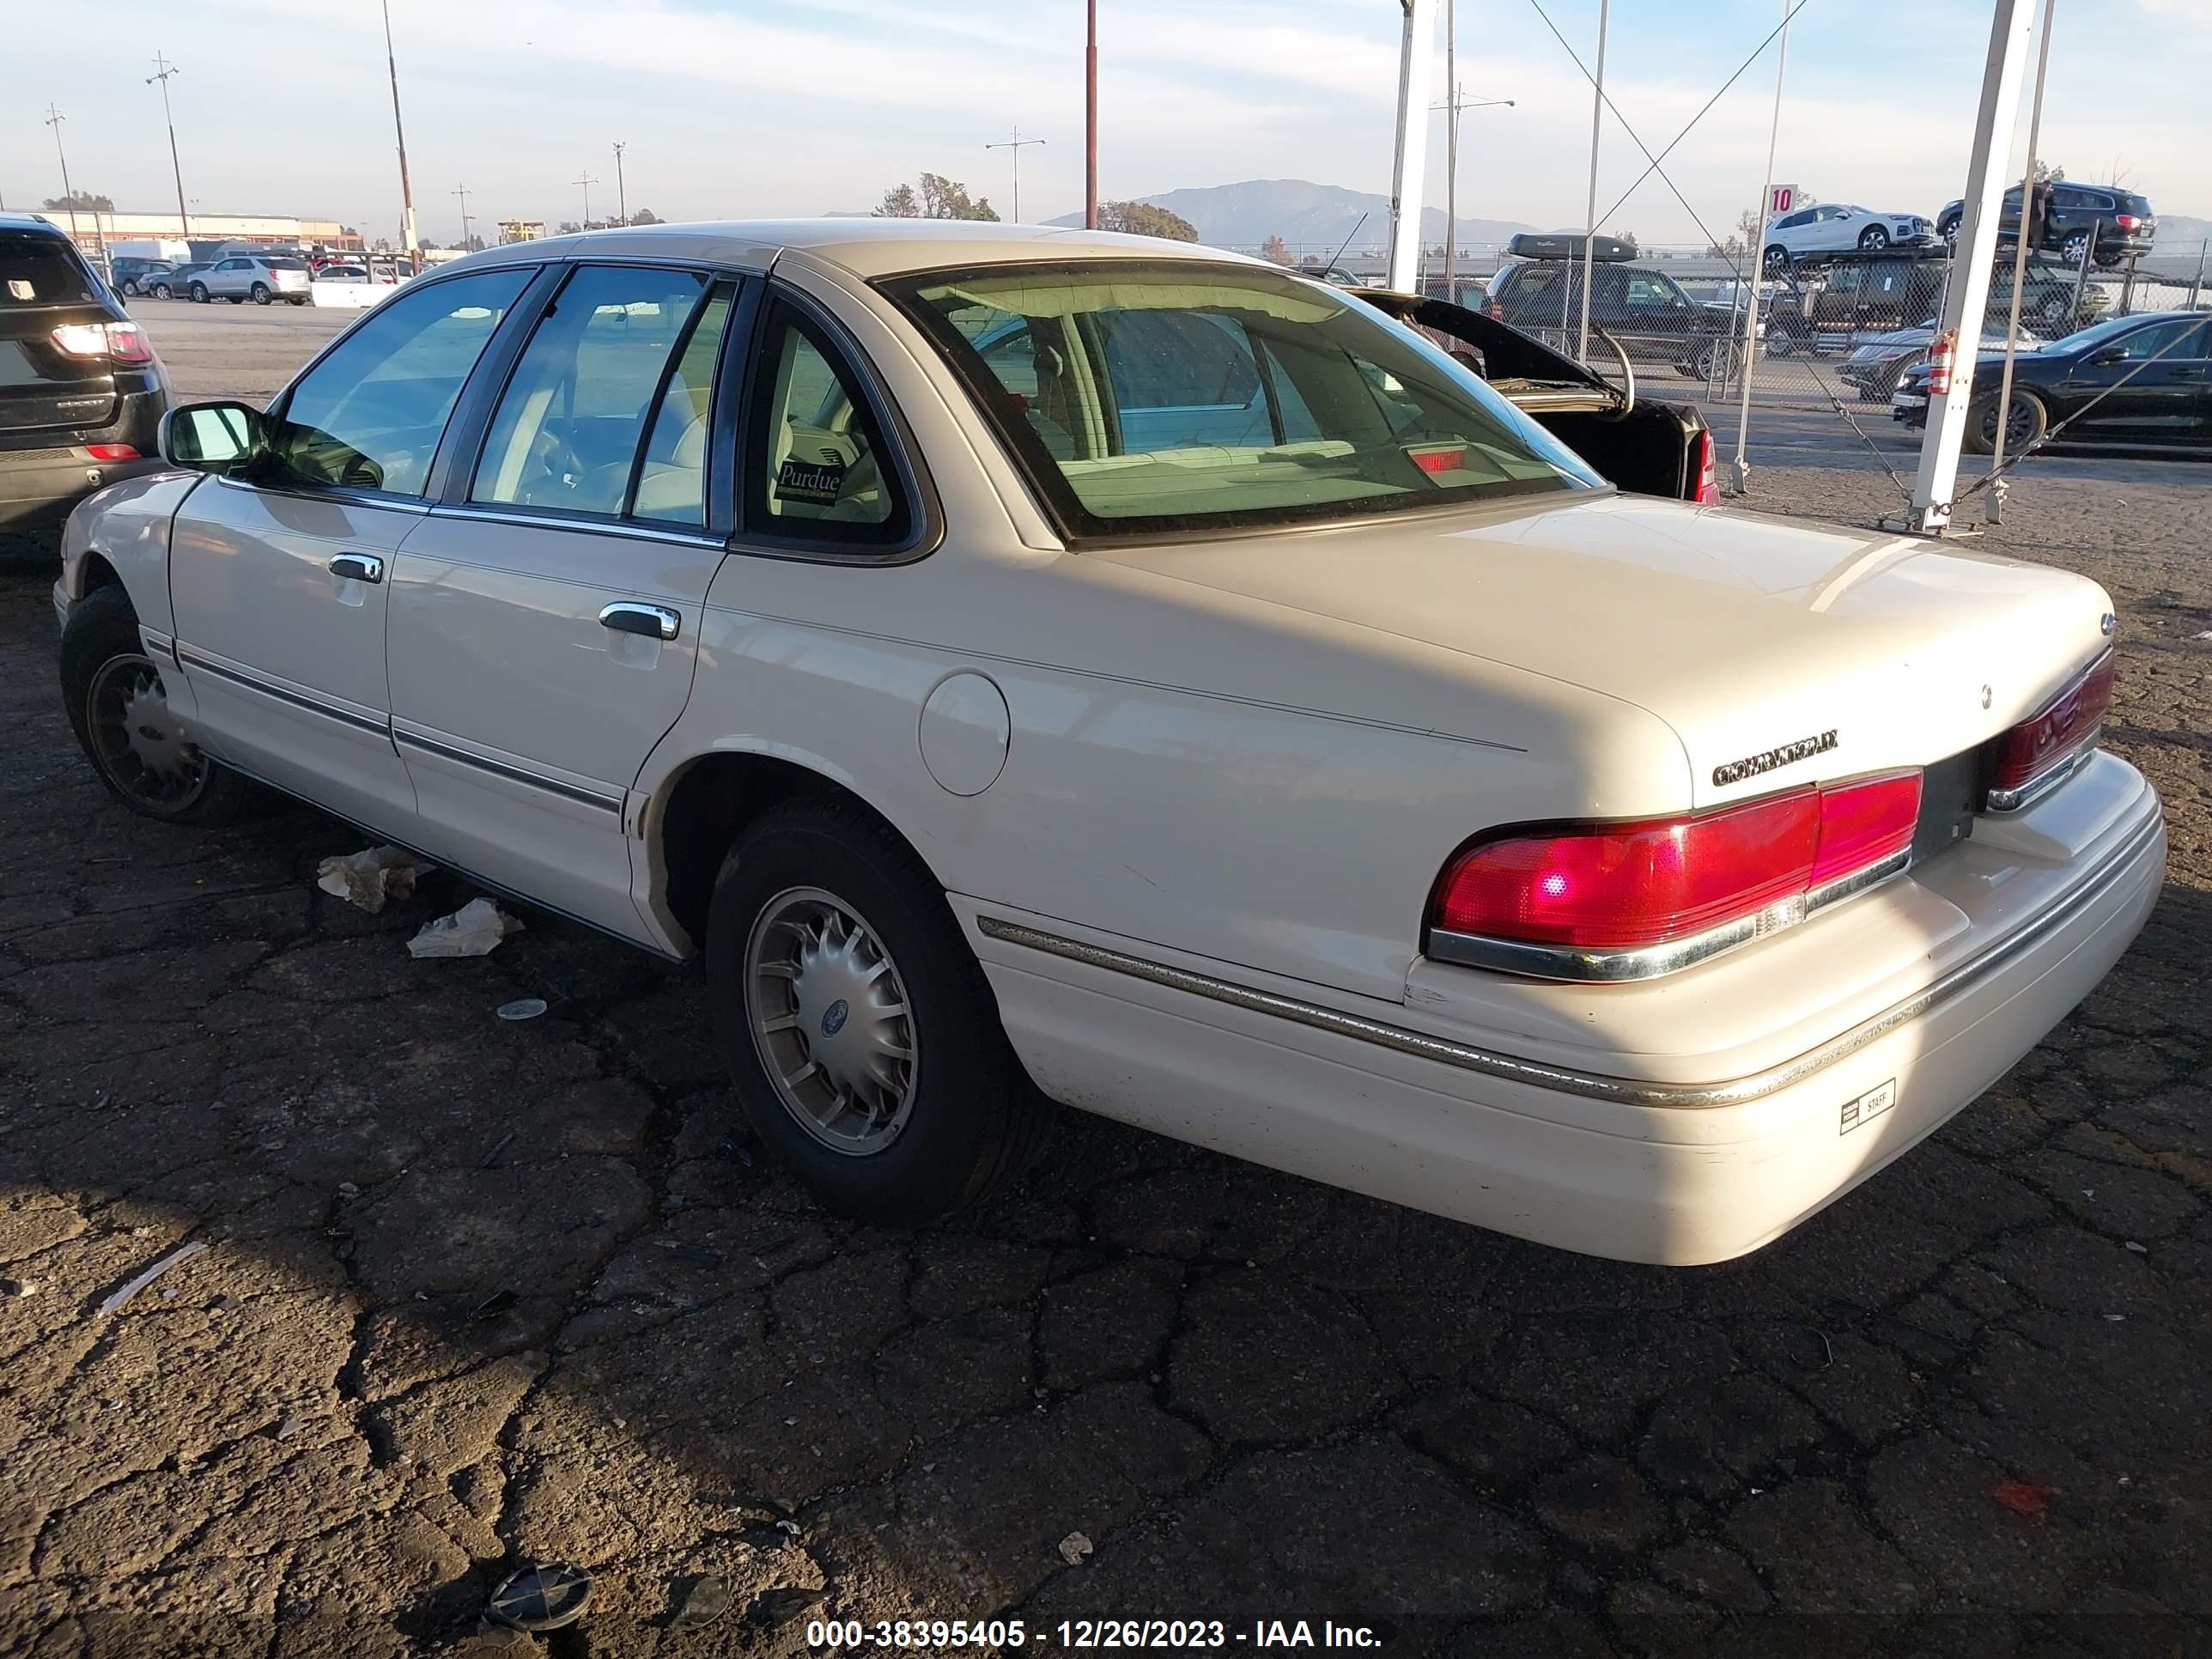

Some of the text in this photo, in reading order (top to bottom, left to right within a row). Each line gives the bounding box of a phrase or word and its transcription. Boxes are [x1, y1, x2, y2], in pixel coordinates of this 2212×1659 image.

[1772, 189, 1791, 211] 10
[780, 465, 840, 490] Purdue
[1868, 1092, 1887, 1112] STAFF
